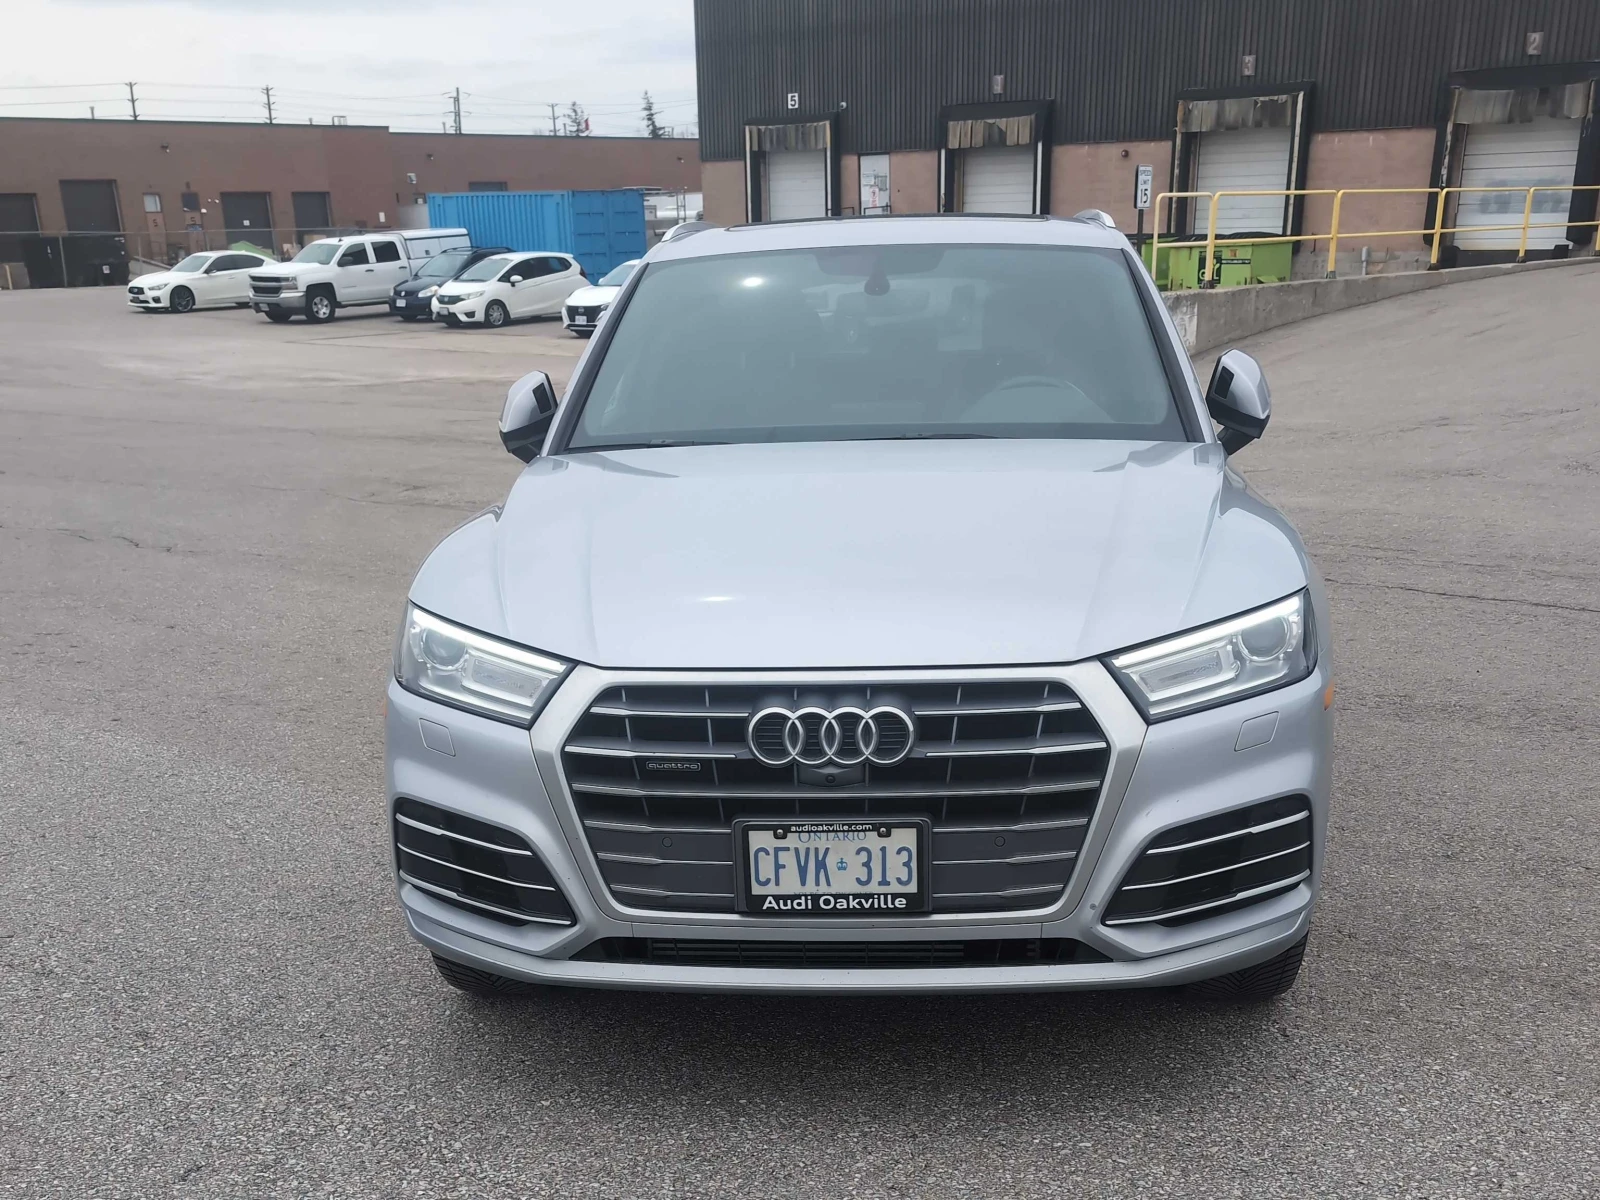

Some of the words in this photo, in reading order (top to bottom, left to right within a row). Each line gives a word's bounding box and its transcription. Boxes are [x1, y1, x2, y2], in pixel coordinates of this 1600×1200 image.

[1529, 33, 1540, 55] 2
[790, 94, 797, 107] 5
[1140, 188, 1149, 204] 15
[790, 823, 873, 832] audioakville.com
[797, 832, 867, 844] ONTARIO
[753, 846, 832, 887] CFVK
[855, 845, 913, 887] 313
[762, 895, 812, 910] Audi
[819, 894, 907, 910] Oakville
